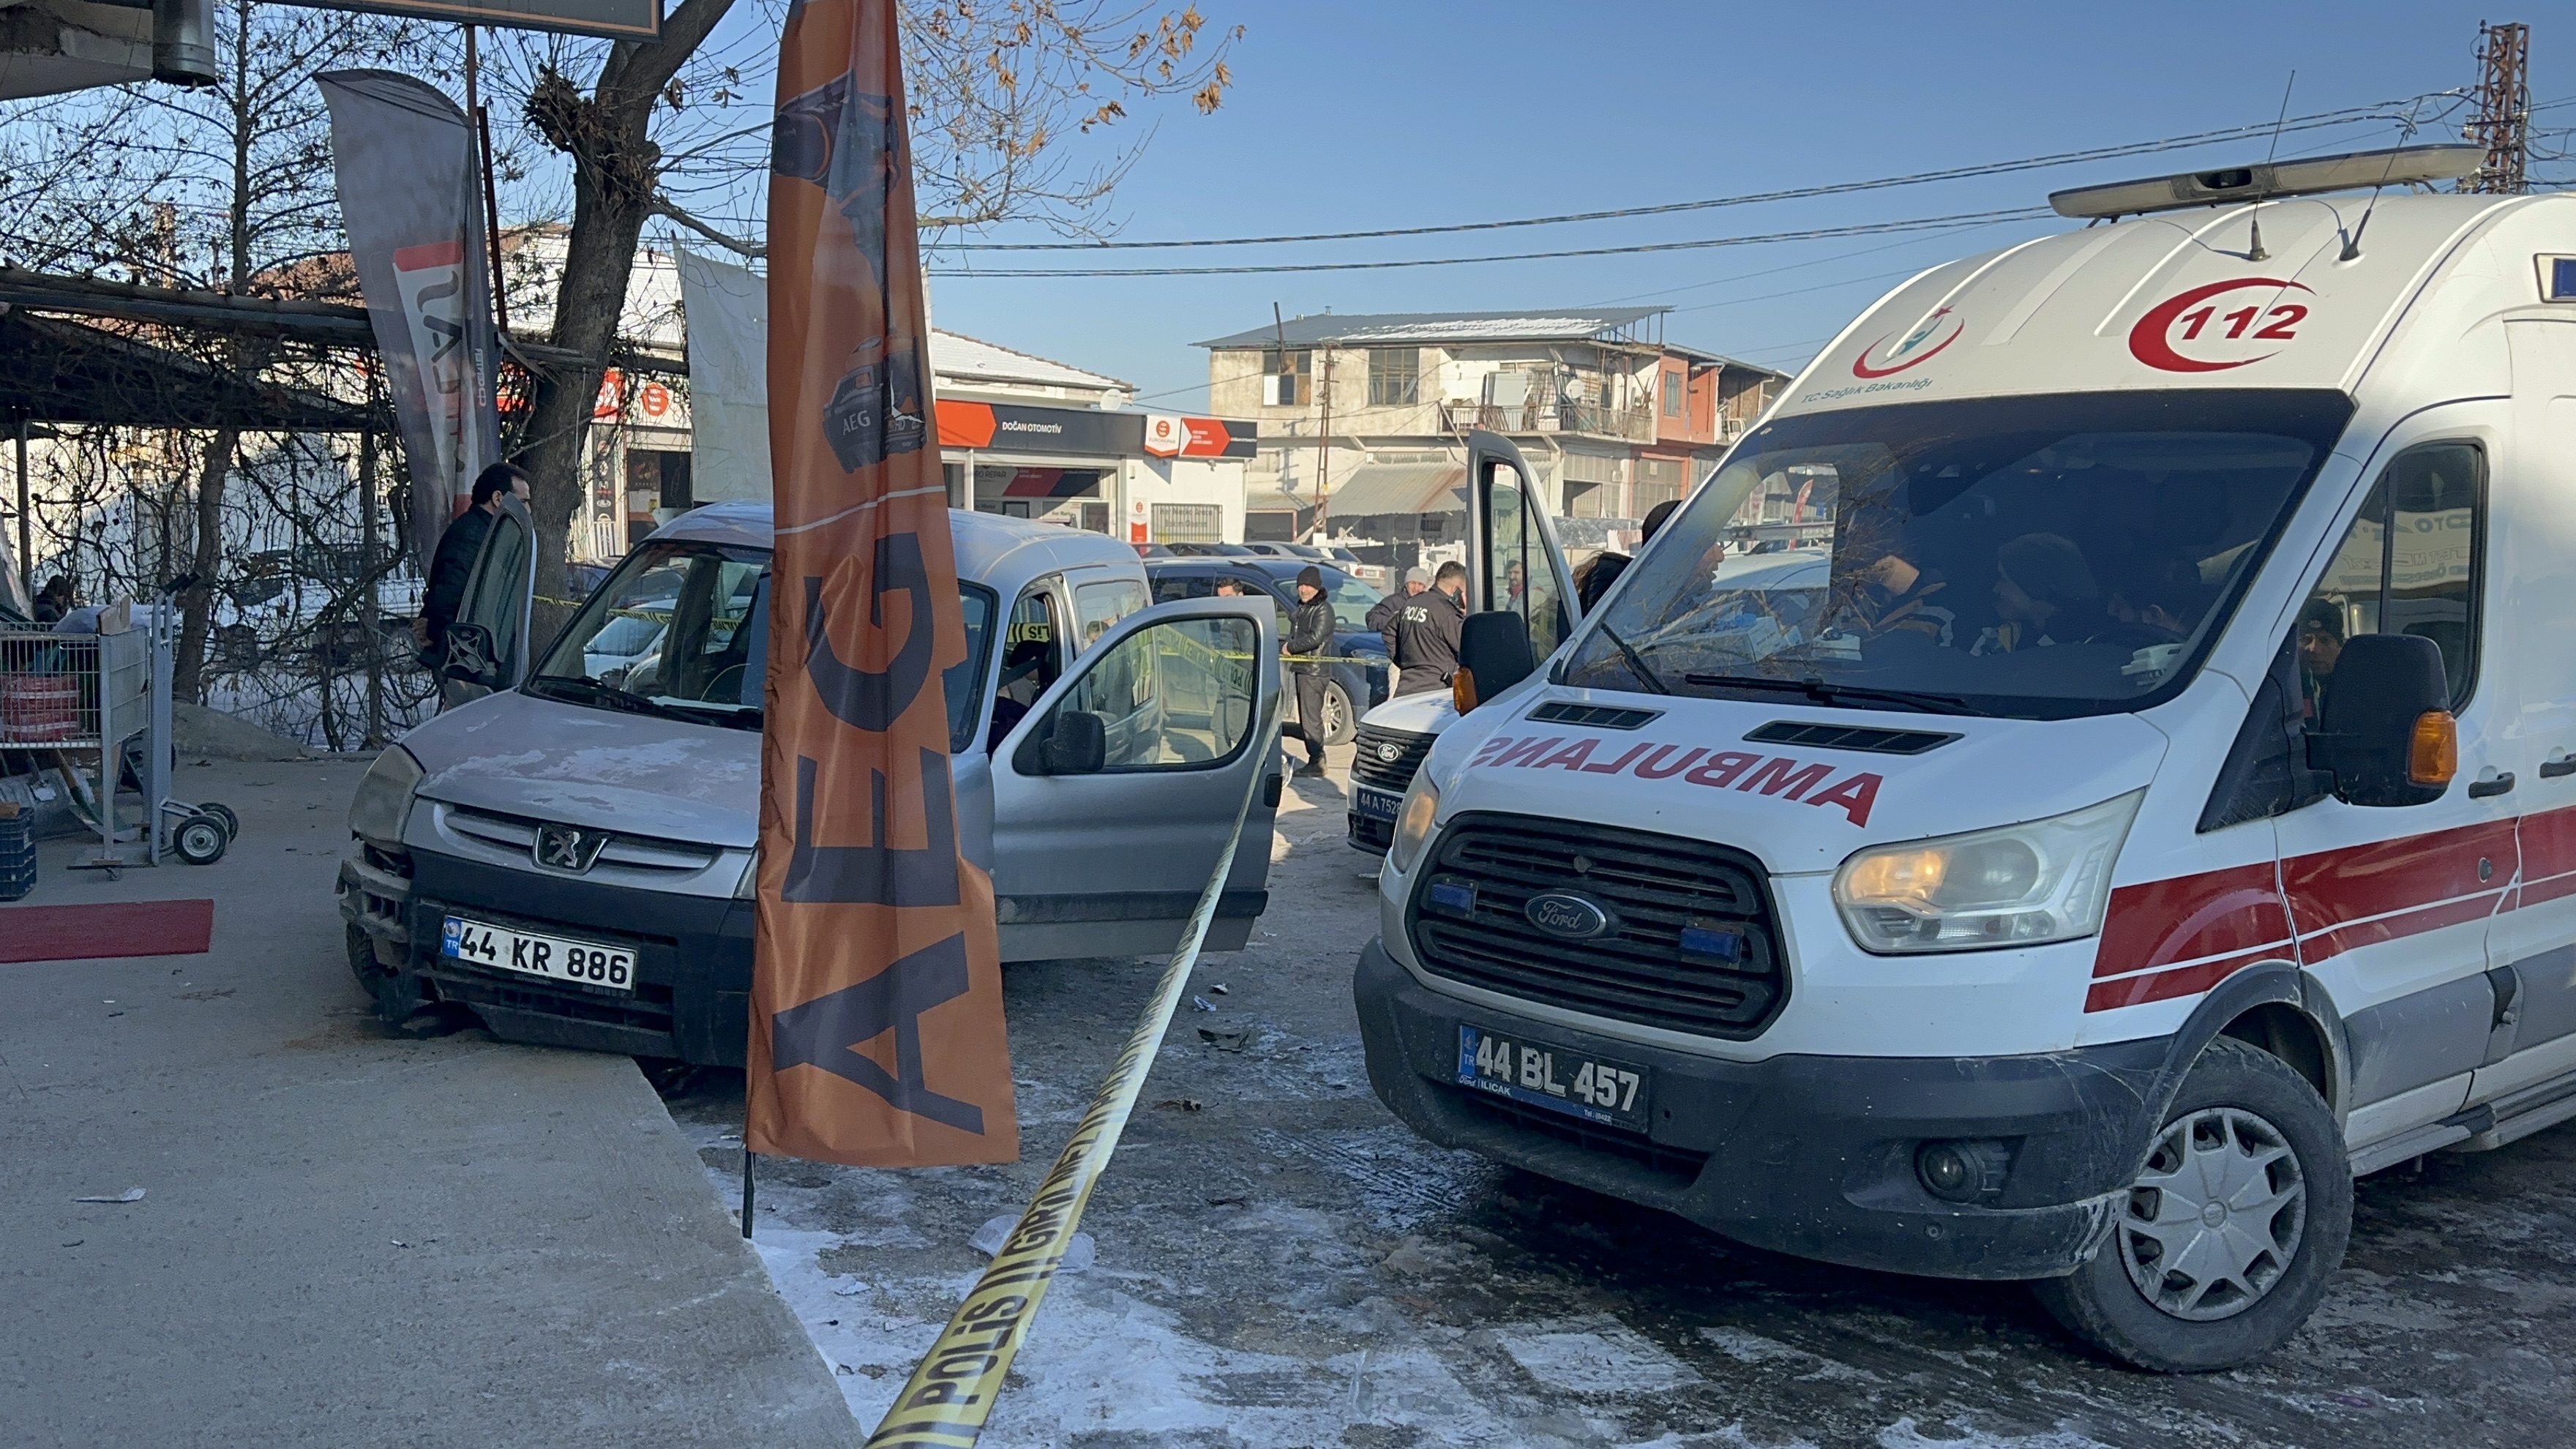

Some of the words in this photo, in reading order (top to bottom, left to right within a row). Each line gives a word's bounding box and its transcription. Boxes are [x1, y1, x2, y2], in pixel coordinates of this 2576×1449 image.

[2180, 304, 2308, 340] 112
[1821, 386, 1865, 400] Sağlık
[1865, 378, 1933, 393] Bakanlığı
[842, 410, 871, 435] AEG
[1002, 421, 1027, 432] DOĞAN
[1027, 423, 1062, 433] OTOMOTİV
[1361, 793, 1370, 808] 44
[1372, 795, 1379, 811] A
[772, 532, 985, 1136] AEG
[1538, 900, 1582, 929] Ford
[446, 939, 458, 951] TR
[460, 926, 496, 962] 44
[512, 937, 552, 973] KR
[567, 947, 629, 985] 886
[1464, 1053, 1475, 1066] TR
[1476, 1036, 1512, 1083] 44
[1520, 1046, 1566, 1098] BL
[1574, 1061, 1640, 1112] 457
